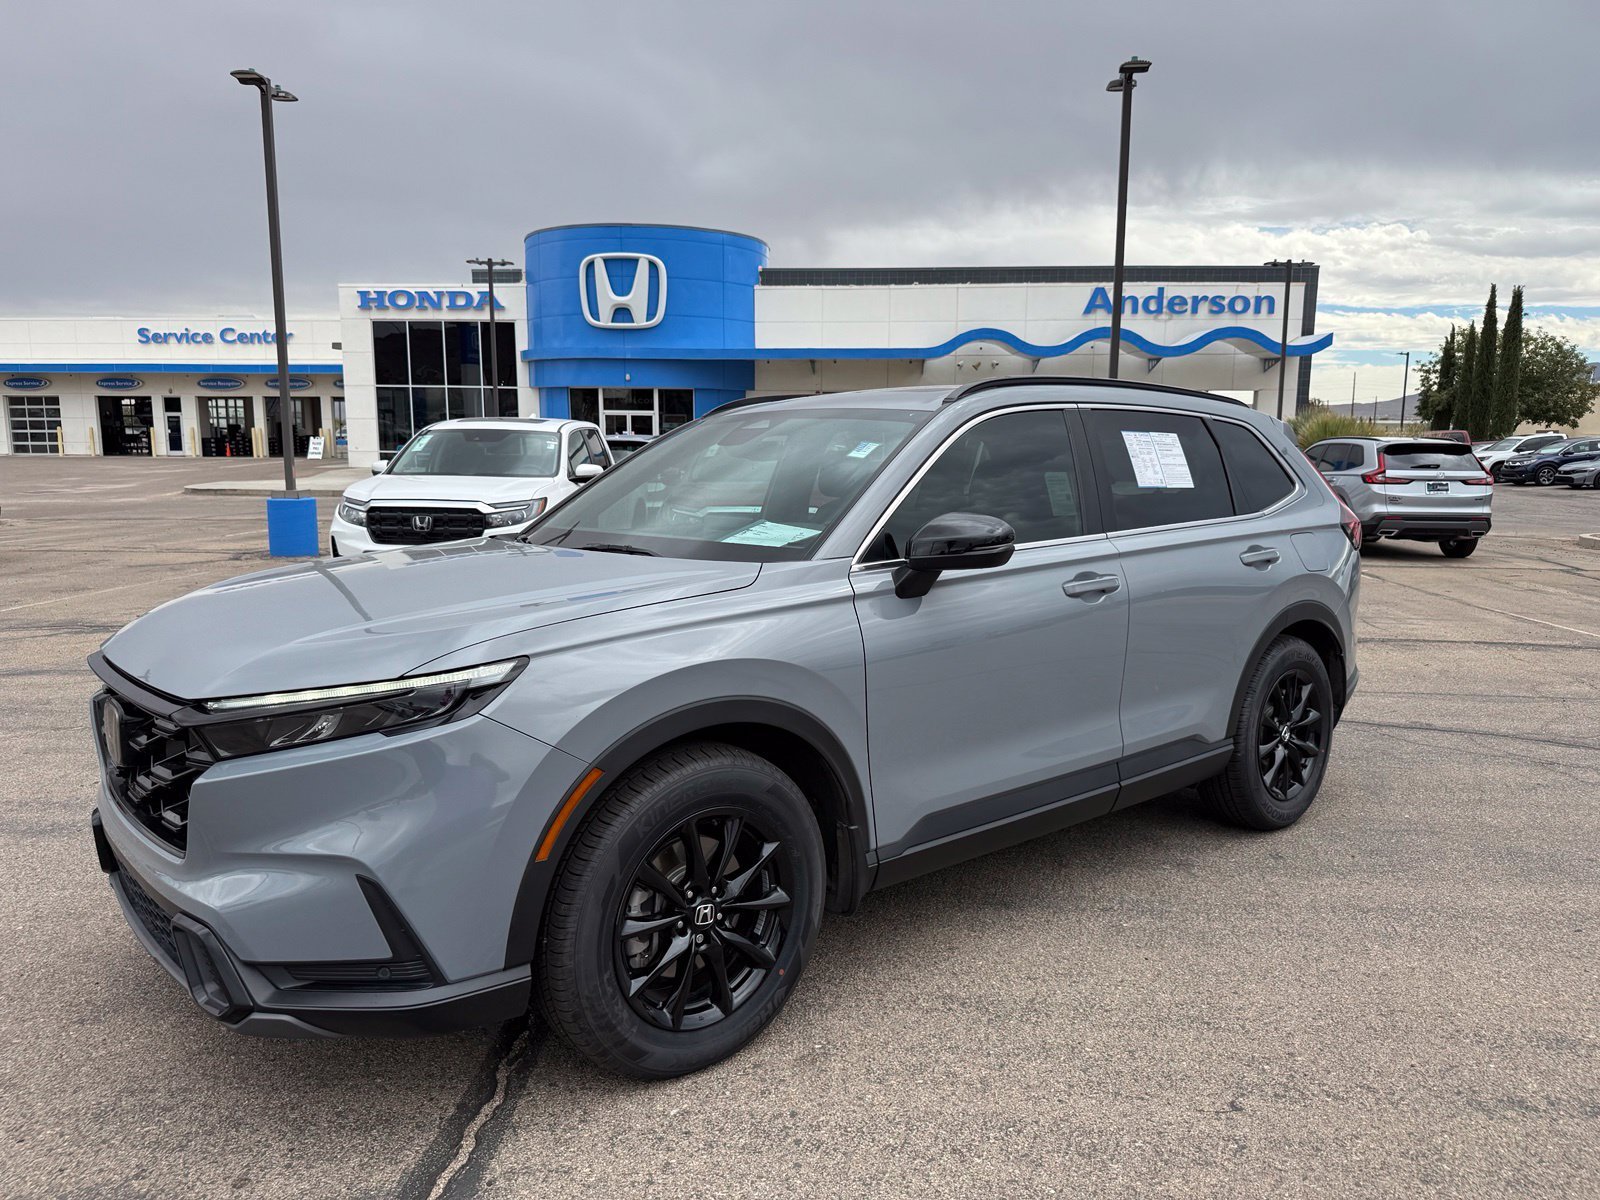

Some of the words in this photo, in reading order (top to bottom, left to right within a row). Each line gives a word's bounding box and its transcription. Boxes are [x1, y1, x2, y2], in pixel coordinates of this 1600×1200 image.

[357, 289, 505, 310] HONDA
[1083, 286, 1276, 315] Anderson
[137, 327, 214, 345] Service
